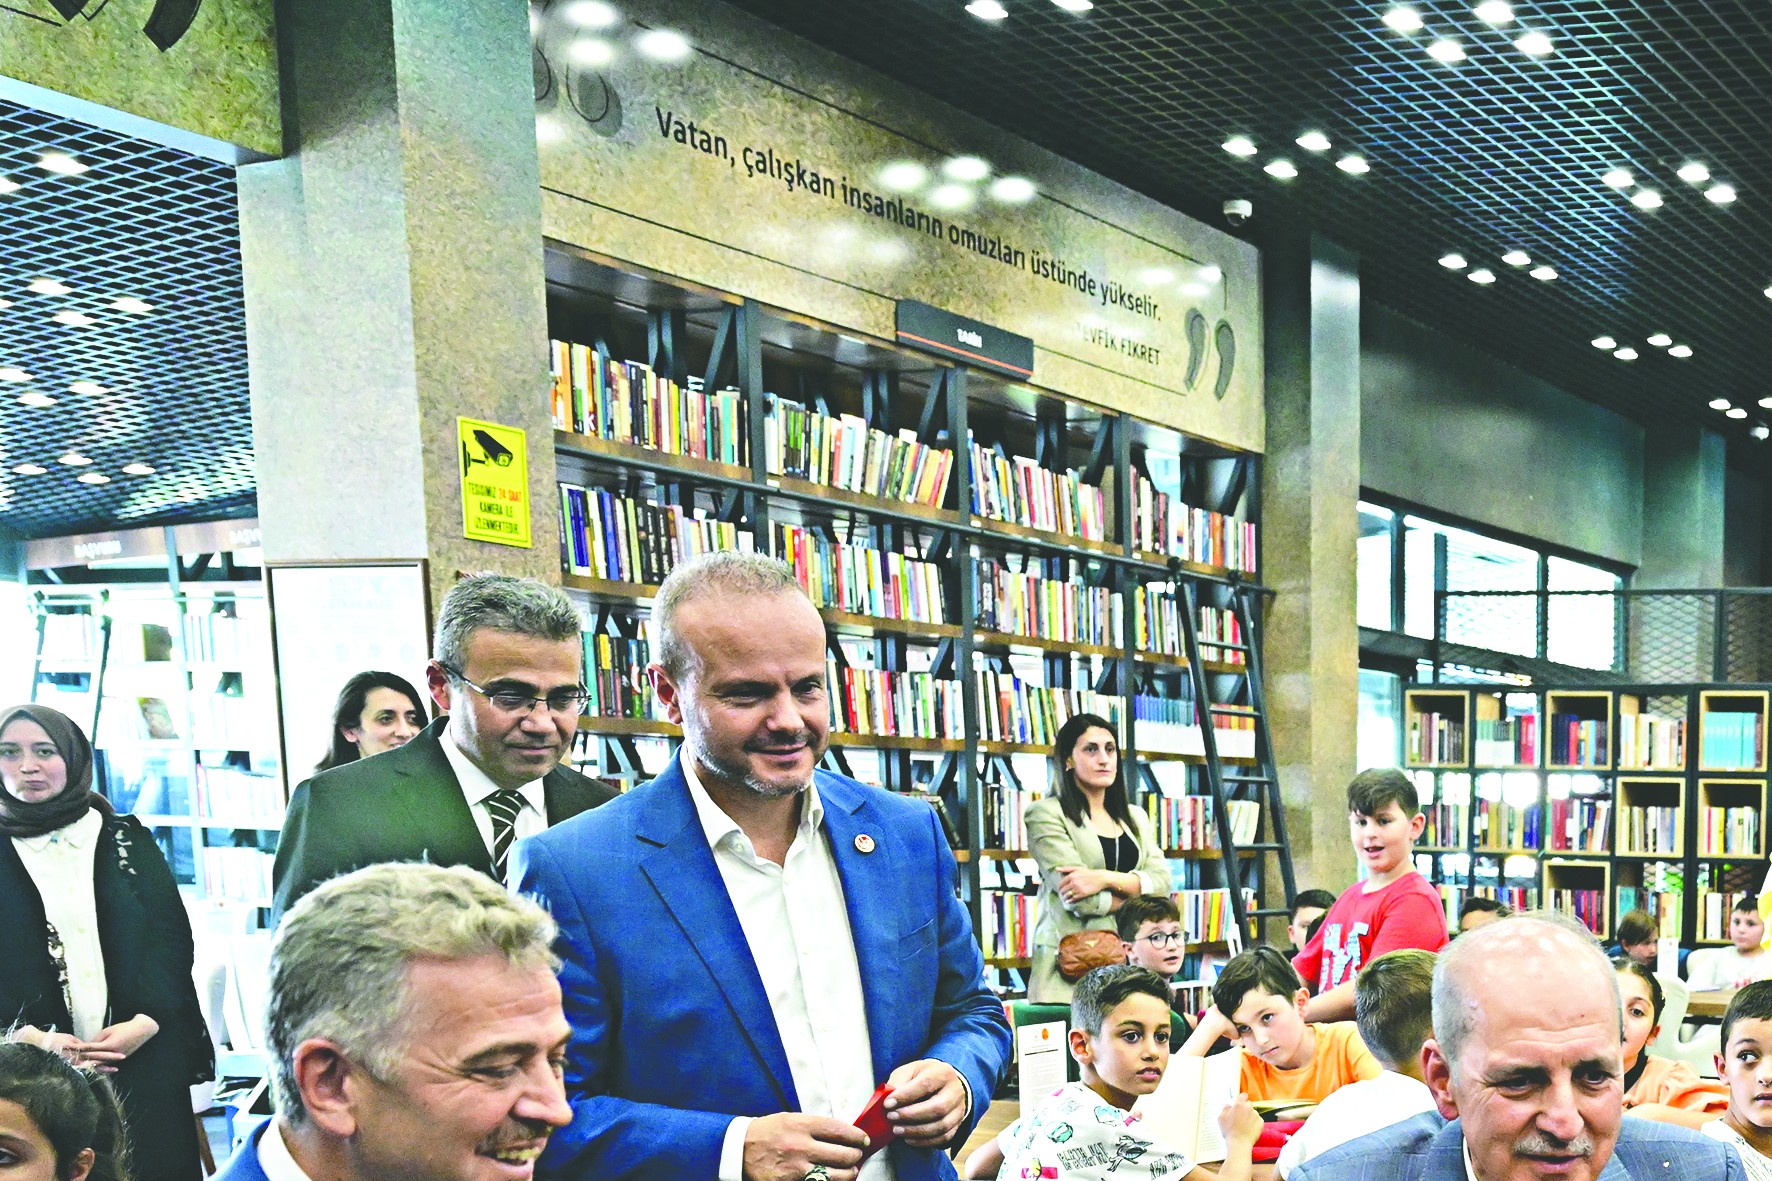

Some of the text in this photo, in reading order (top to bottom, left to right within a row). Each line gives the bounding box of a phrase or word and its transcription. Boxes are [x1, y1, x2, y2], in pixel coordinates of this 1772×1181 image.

[656, 106, 1162, 321] Vatan, çalışkan insanların omuzları üstünde yükselir.
[480, 502, 503, 515] KAMERA
